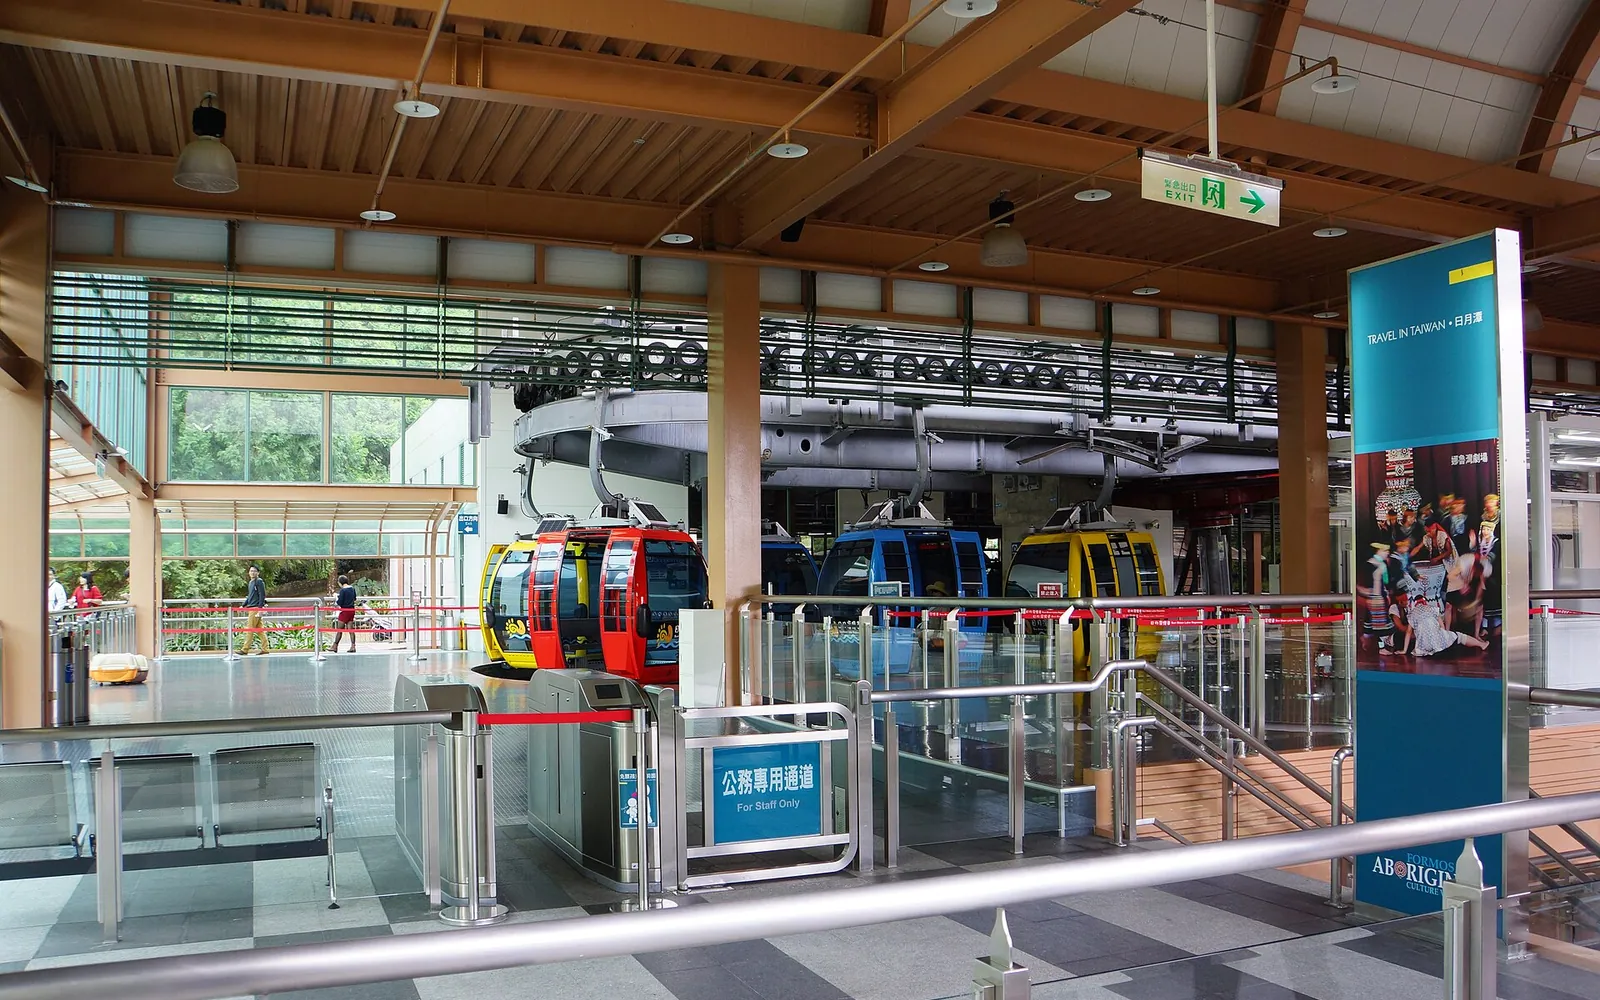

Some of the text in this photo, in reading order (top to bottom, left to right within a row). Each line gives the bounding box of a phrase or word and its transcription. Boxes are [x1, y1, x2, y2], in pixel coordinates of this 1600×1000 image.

[1164, 179, 1197, 193] 緊急出口
[1165, 190, 1195, 203] EXIT
[1455, 310, 1483, 328] 日月潭
[1367, 319, 1446, 345] TRAVEL IN TAIWAN
[722, 763, 814, 797] 公務專用通道
[737, 798, 800, 812] For Staff Only
[1406, 852, 1455, 873] FORMOS
[1406, 881, 1439, 896] CULTURE
